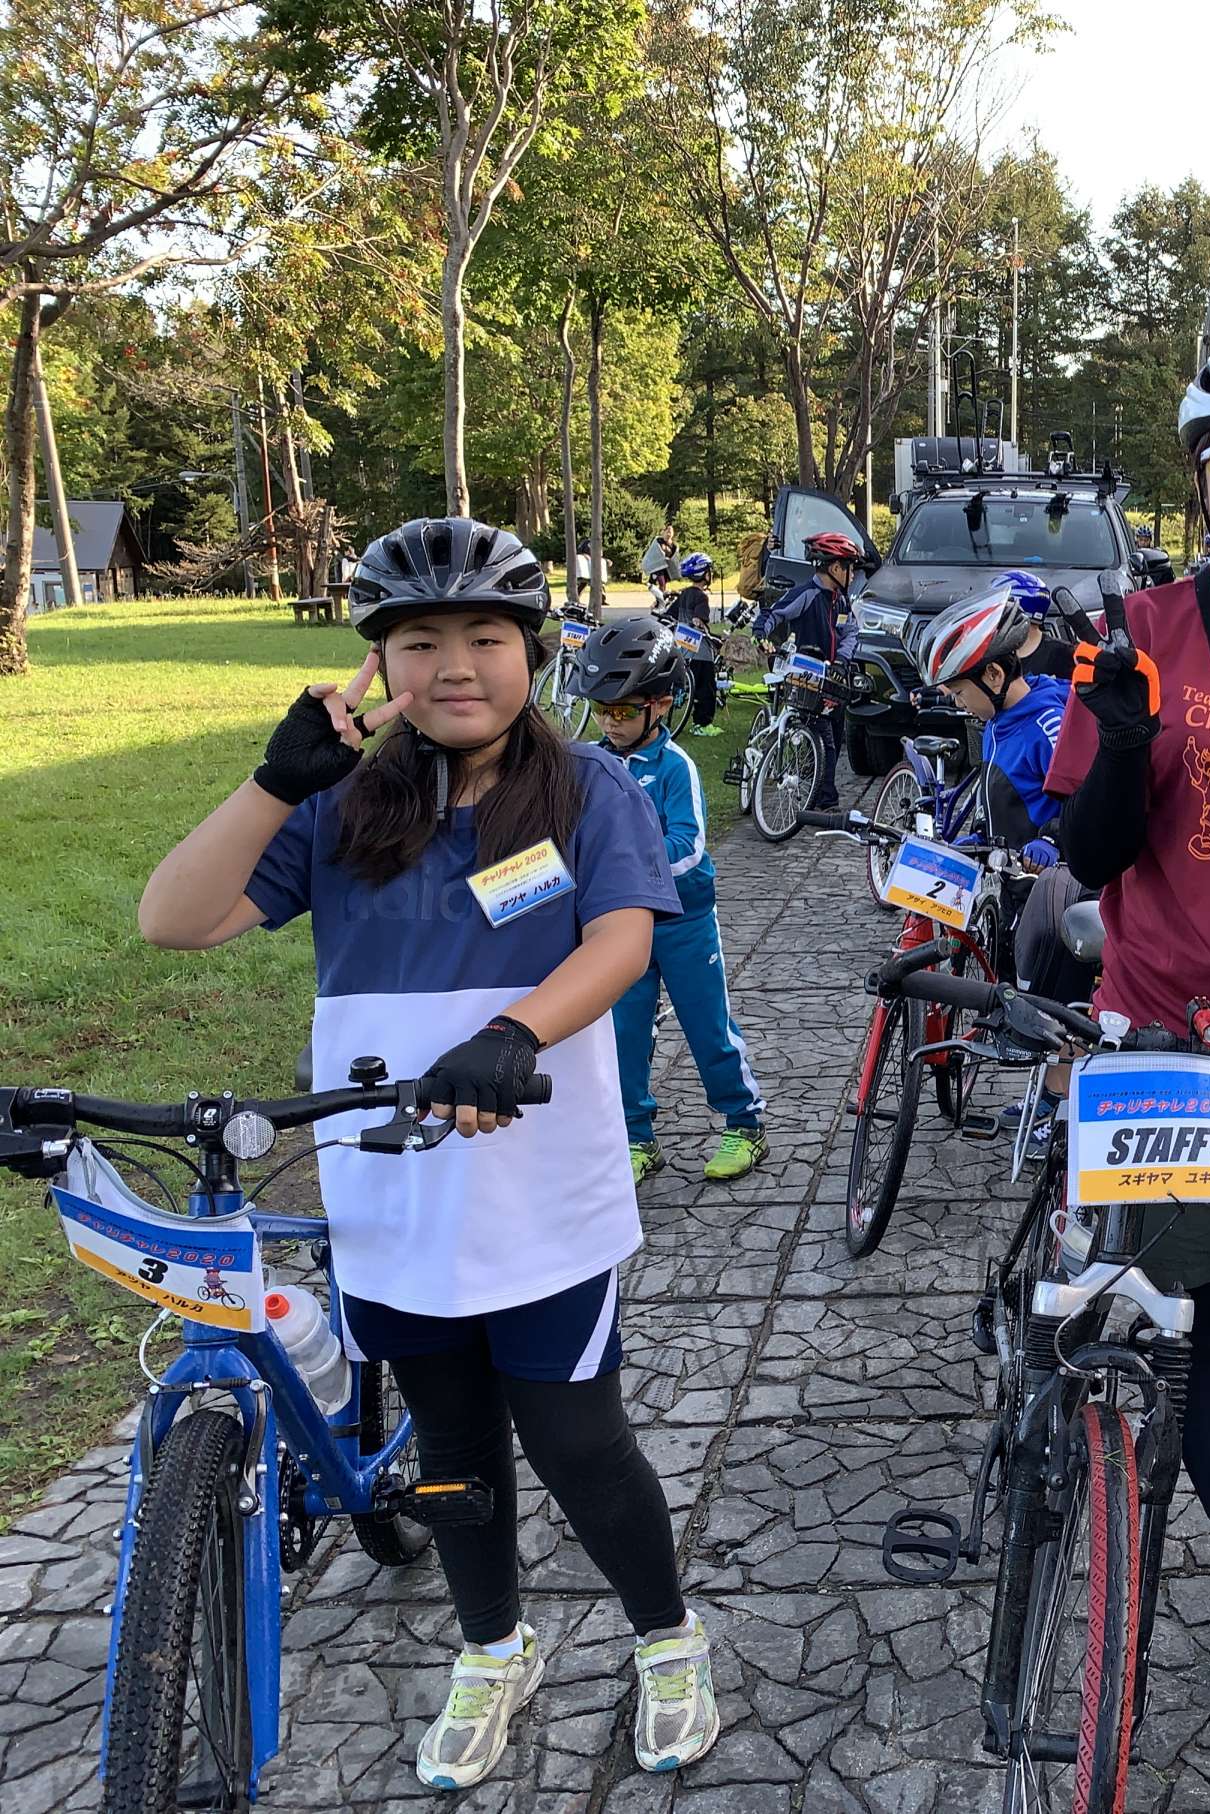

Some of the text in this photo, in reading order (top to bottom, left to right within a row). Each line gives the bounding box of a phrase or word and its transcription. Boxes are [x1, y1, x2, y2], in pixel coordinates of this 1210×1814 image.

[525, 848, 548, 865] 2020
[499, 892, 527, 912] アツヤ
[533, 875, 561, 895] ハルカ
[926, 881, 946, 899] 2
[1118, 1172, 1174, 1187] スギヤマ
[137, 1257, 169, 1284] 3
[115, 1269, 204, 1314] アツヤ ハルカ
